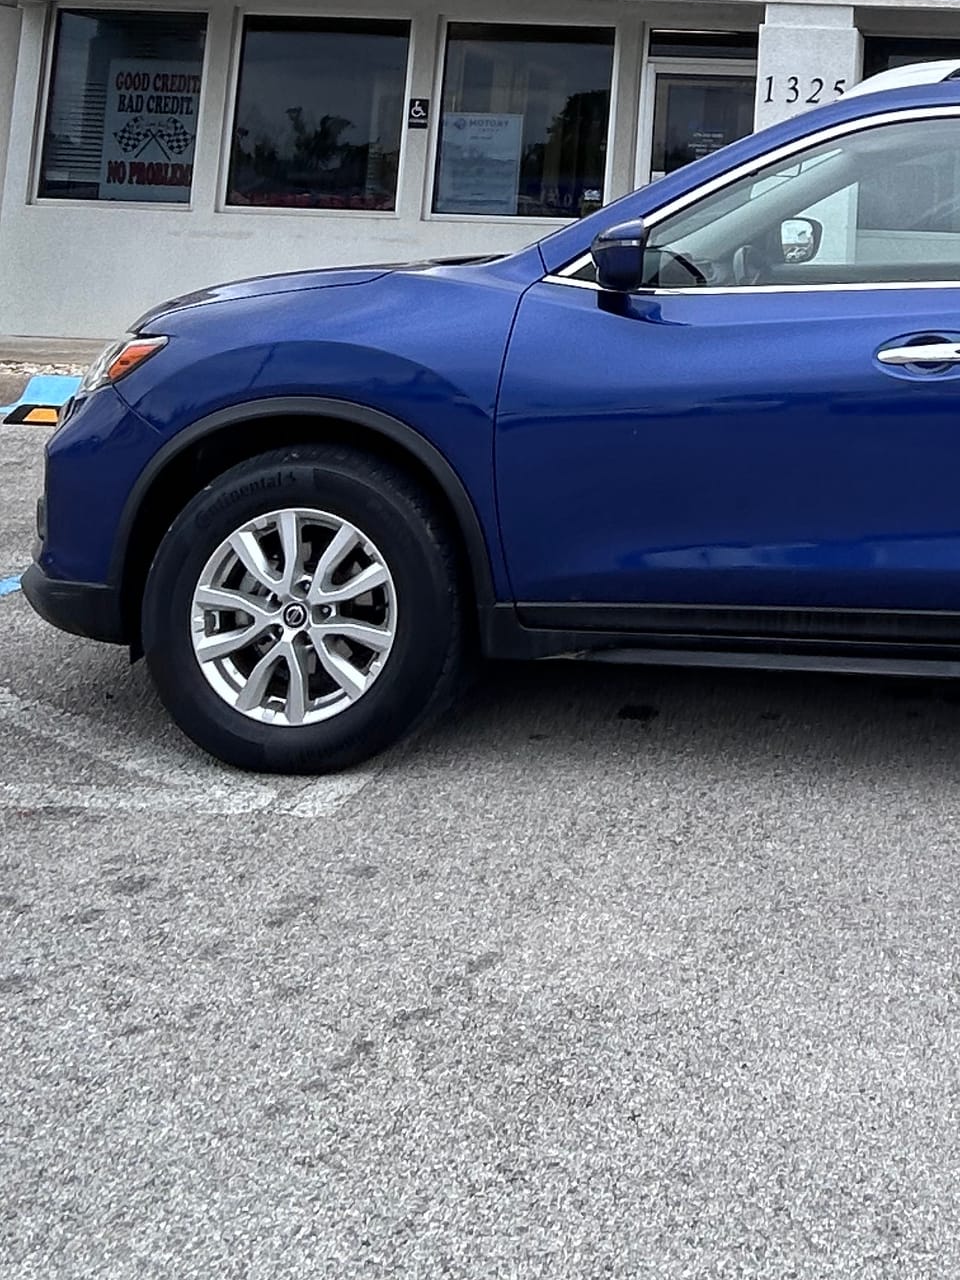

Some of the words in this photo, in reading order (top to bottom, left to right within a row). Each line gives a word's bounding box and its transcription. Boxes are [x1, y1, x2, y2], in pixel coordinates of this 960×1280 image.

[115, 71, 150, 92] GOOD
[763, 75, 846, 104] 1325
[117, 94, 144, 113] BAD
[106, 159, 127, 185] NO
